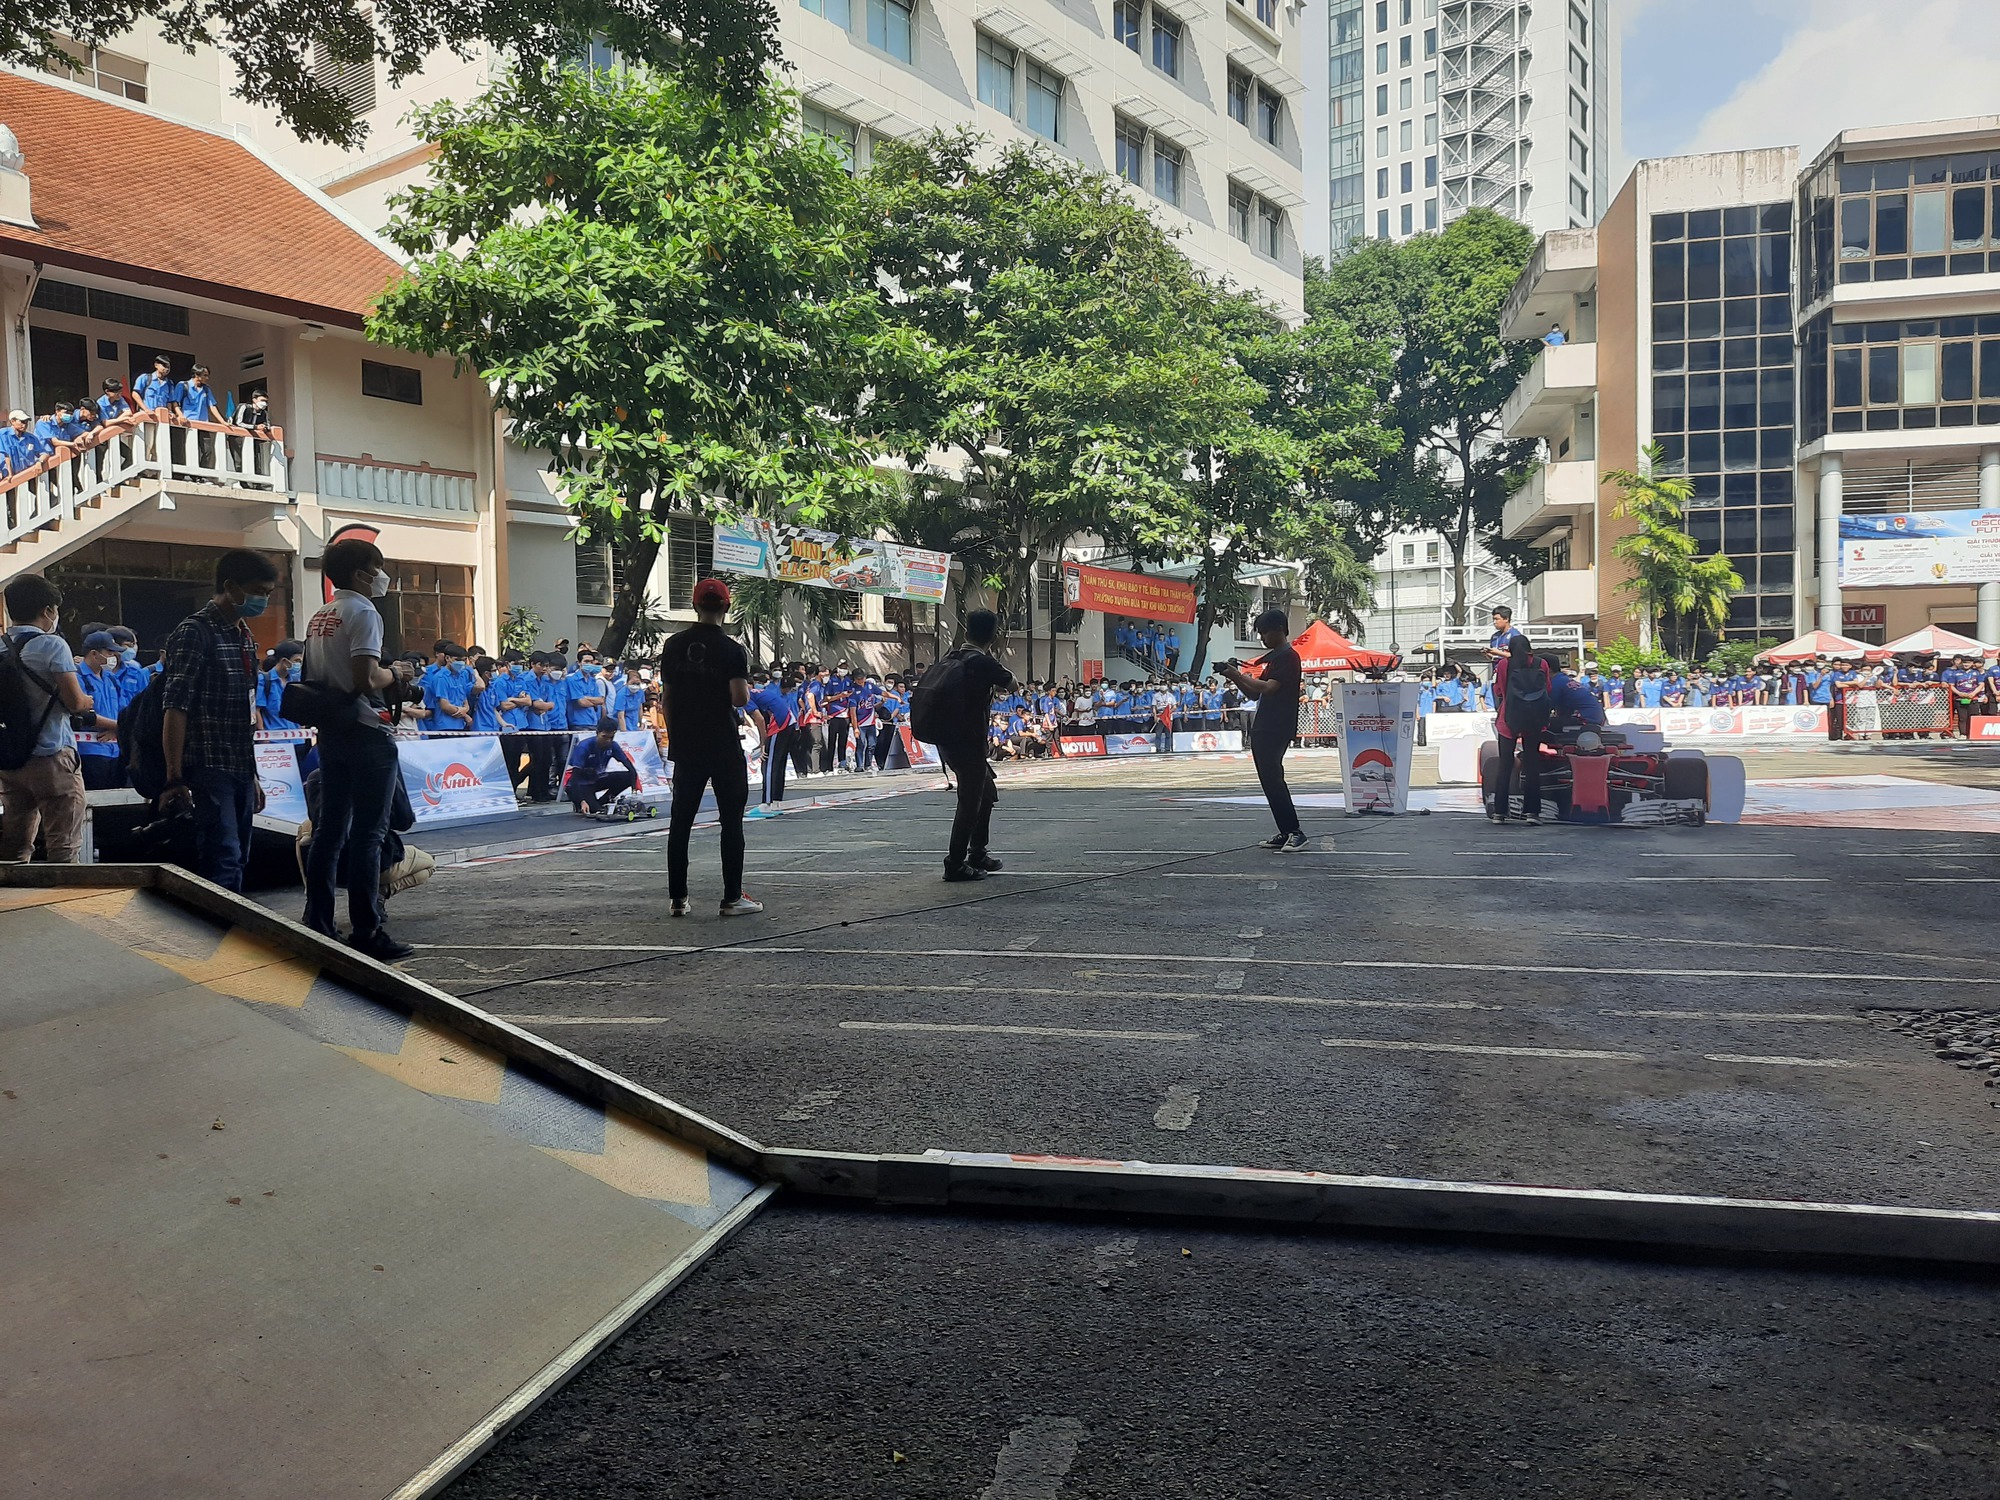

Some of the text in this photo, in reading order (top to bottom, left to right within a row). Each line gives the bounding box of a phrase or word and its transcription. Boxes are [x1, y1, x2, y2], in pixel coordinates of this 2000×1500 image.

[791, 539, 823, 561] MINI
[780, 560, 831, 579] RACING
[1300, 657, 1346, 669] otul.com
[1060, 741, 1099, 754] MOTUL
